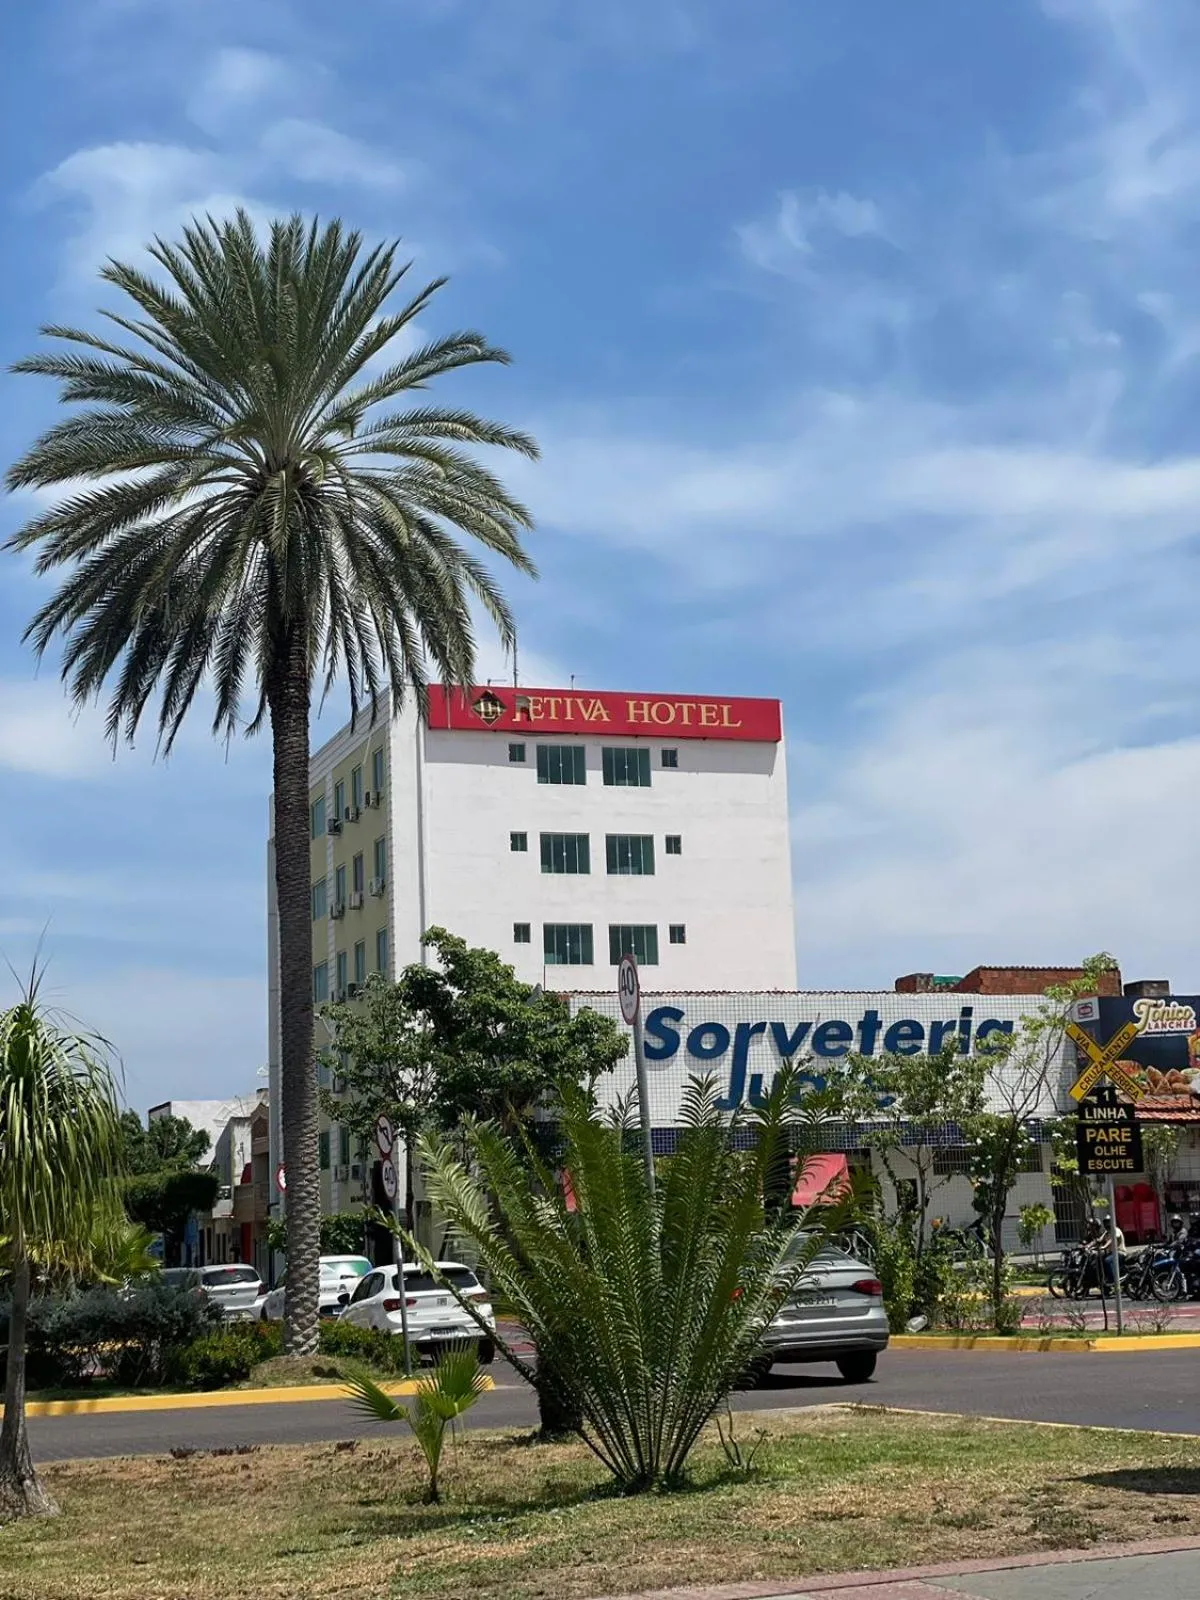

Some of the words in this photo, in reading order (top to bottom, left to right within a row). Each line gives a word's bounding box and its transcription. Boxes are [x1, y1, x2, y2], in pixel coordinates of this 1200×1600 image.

[626, 700, 743, 728] HOTEL
[621, 965, 635, 997] 40
[1147, 1019, 1195, 1031] LANCHES
[643, 1005, 1014, 1062] Sorveteria
[1076, 1033, 1091, 1051] VIA
[1079, 1032, 1131, 1091] CRUZAMENTO
[1103, 1089, 1110, 1102] 1
[1084, 1107, 1128, 1120] LINHA
[1085, 1127, 1133, 1143] PARE
[1094, 1145, 1128, 1157] OLHE
[1087, 1158, 1135, 1170] ESCUTE
